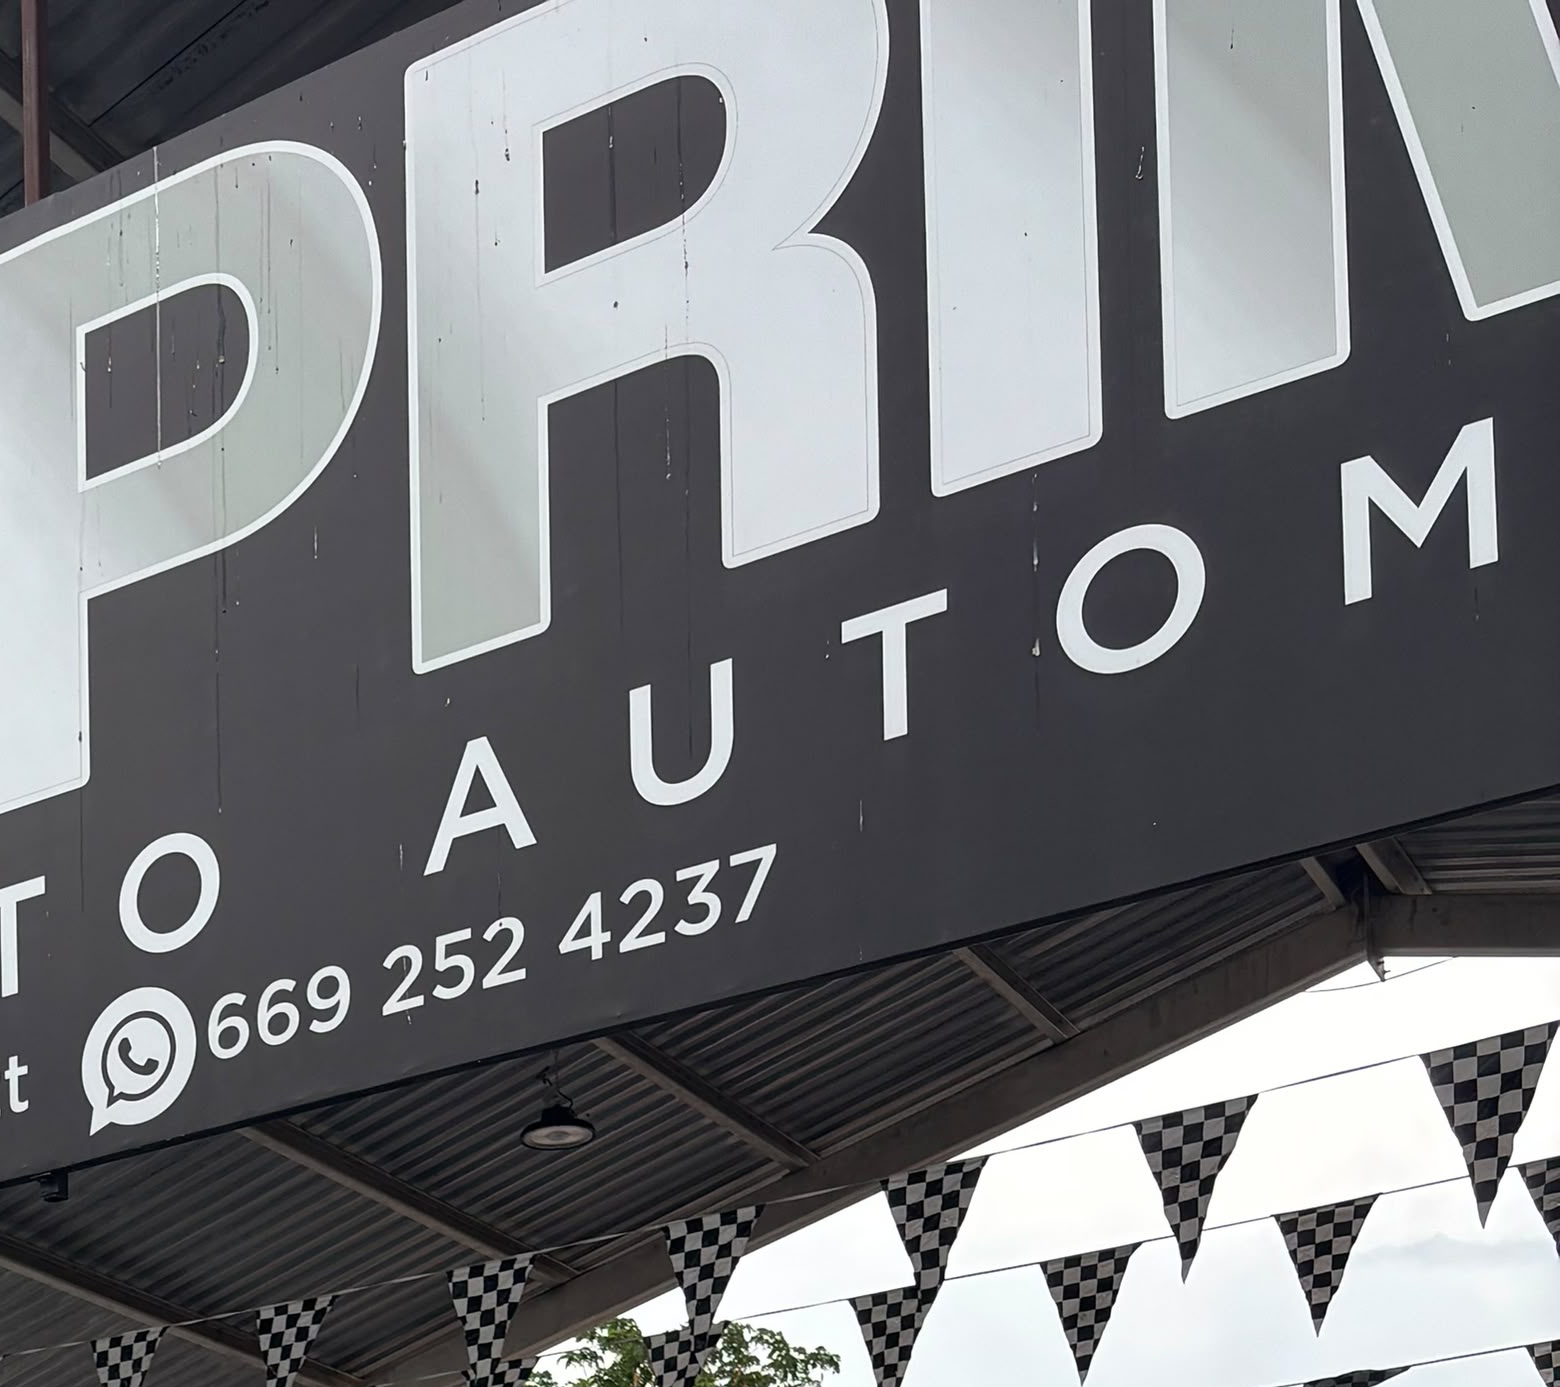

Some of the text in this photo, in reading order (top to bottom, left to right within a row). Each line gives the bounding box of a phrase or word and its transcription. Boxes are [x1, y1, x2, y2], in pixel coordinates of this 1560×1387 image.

[423, 417, 1499, 876] AUTOM
[207, 965, 351, 1059] 669
[381, 915, 527, 1017] 252
[558, 844, 777, 961] 4237
